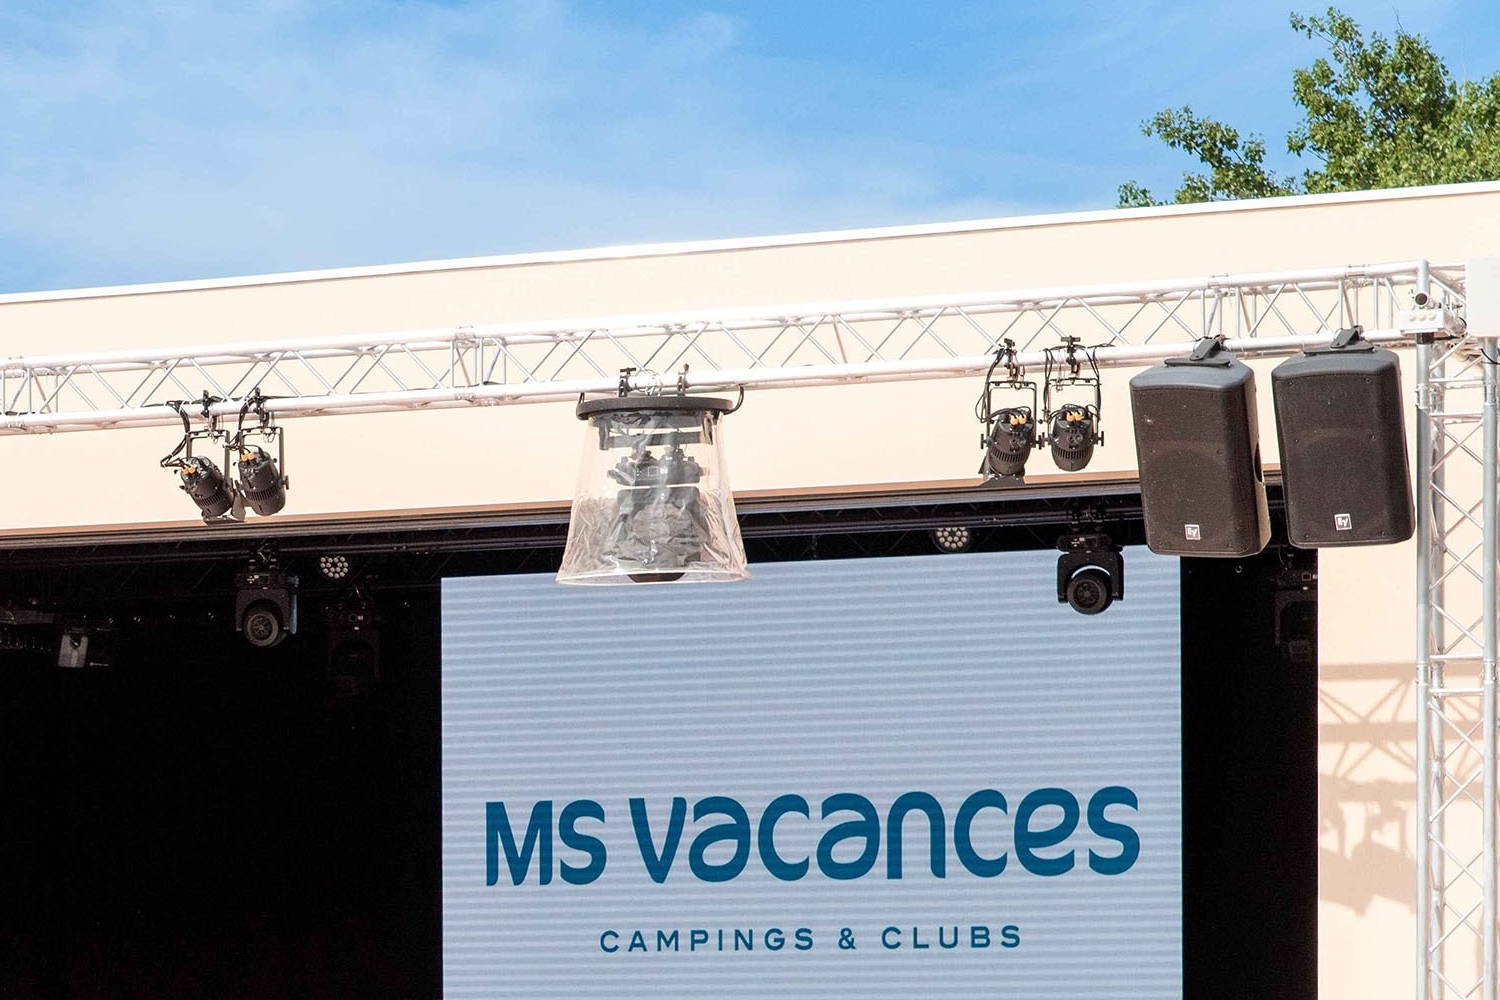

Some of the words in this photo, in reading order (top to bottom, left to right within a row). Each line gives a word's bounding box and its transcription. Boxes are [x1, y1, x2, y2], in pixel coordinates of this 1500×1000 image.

[485, 799, 607, 887] MS
[600, 927, 814, 953] CAMPINGS
[838, 927, 856, 950] &
[881, 925, 1020, 949] CLUBS
